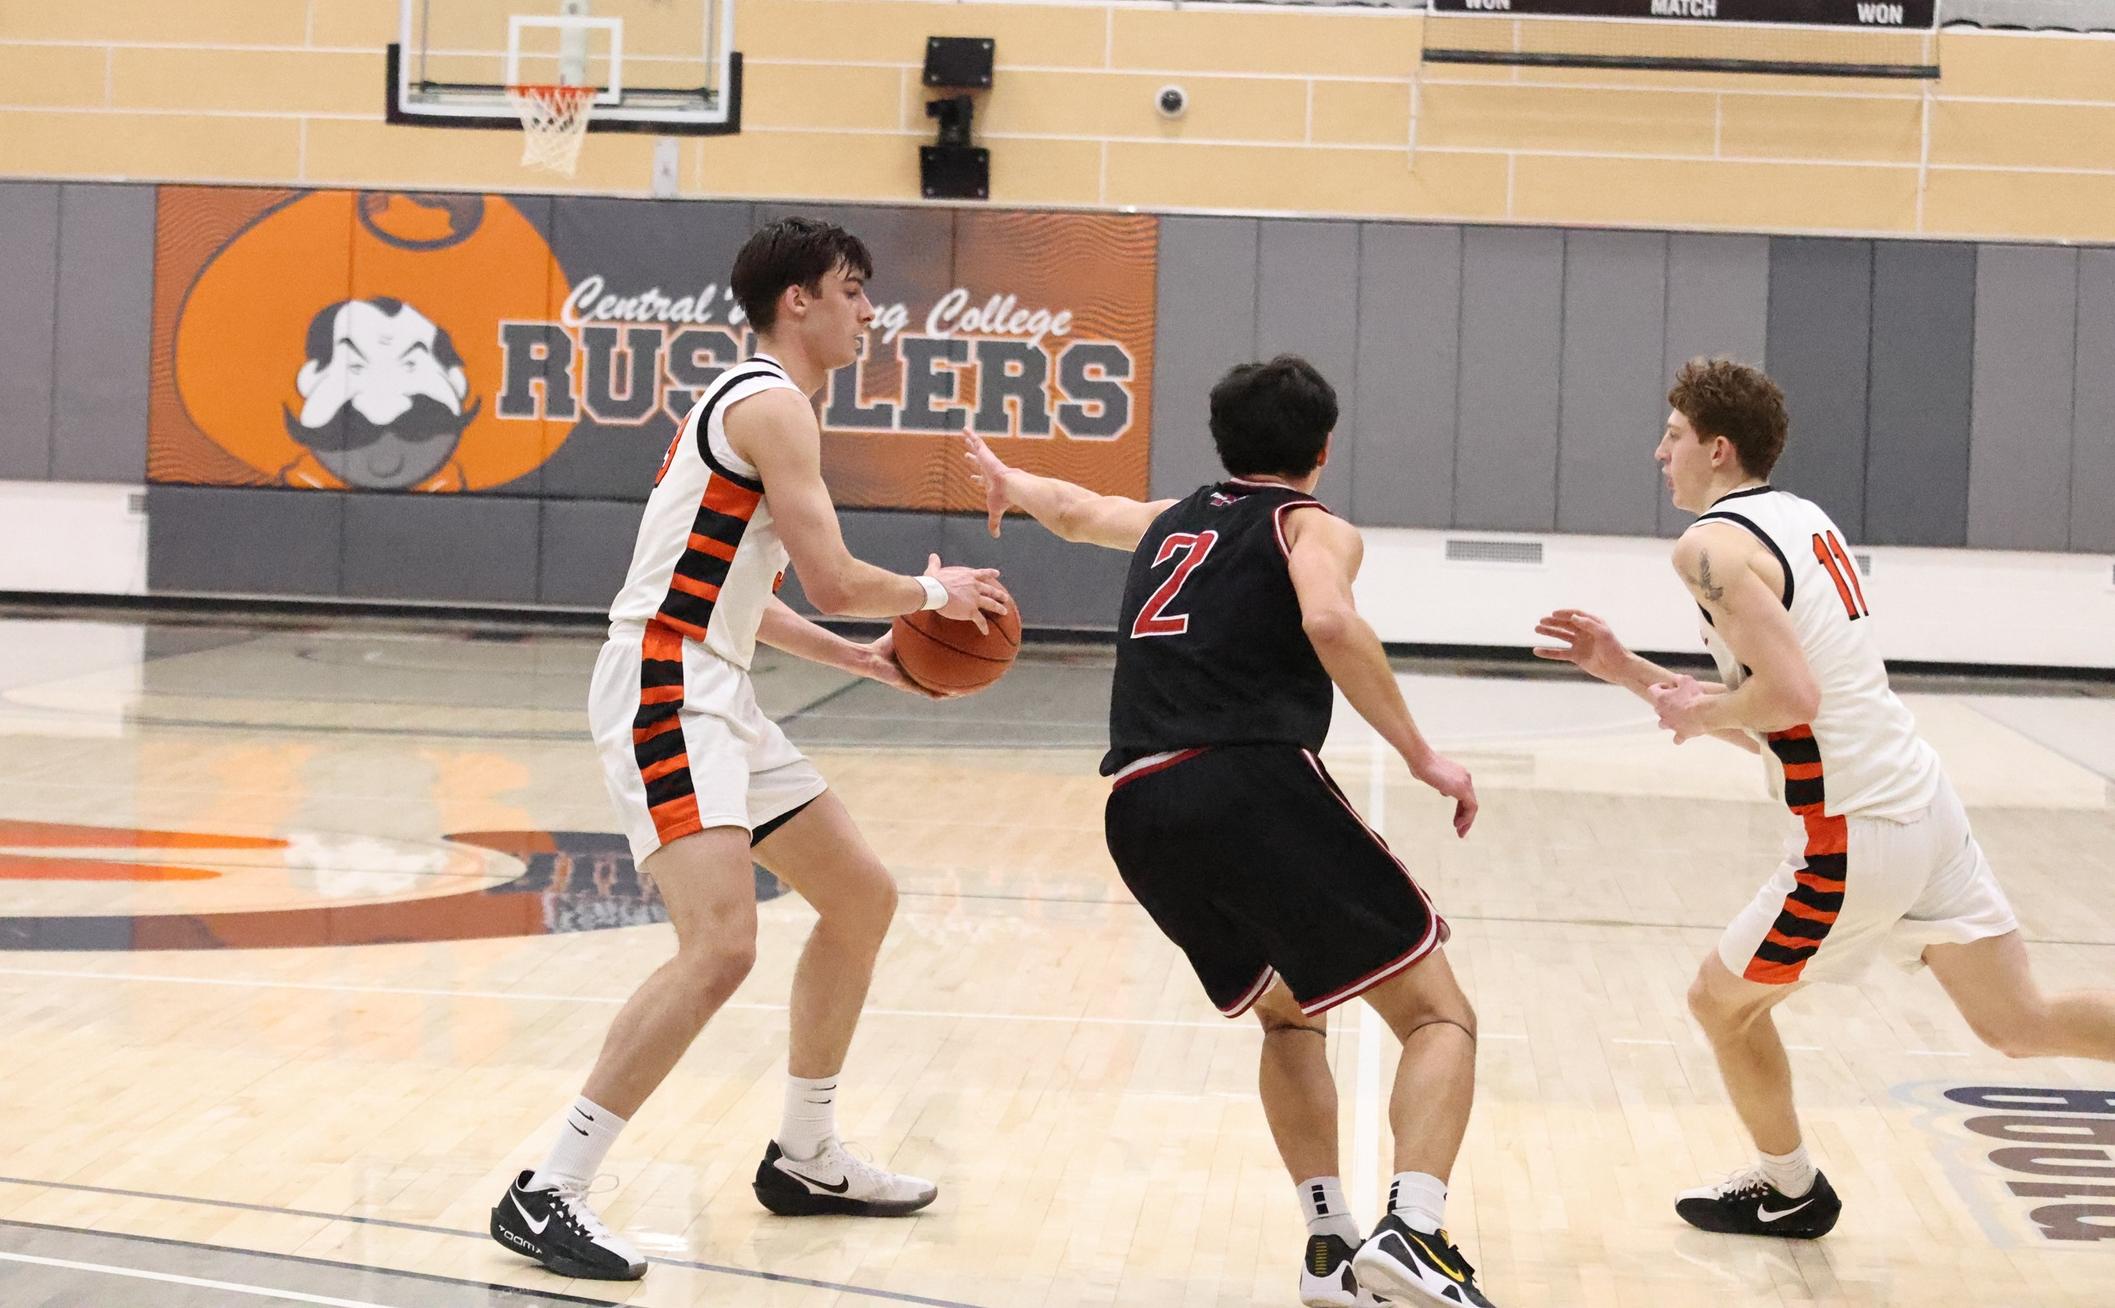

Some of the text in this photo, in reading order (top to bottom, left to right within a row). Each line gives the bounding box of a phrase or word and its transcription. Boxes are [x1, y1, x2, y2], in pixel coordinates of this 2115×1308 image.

[1650, 0, 1717, 17] MATCH
[1857, 3, 1904, 24] WON
[561, 275, 717, 327] Central
[926, 288, 1073, 349] College
[495, 318, 1135, 442] RUSLERS
[1131, 529, 1219, 639] 2
[1812, 530, 1869, 621] 11
